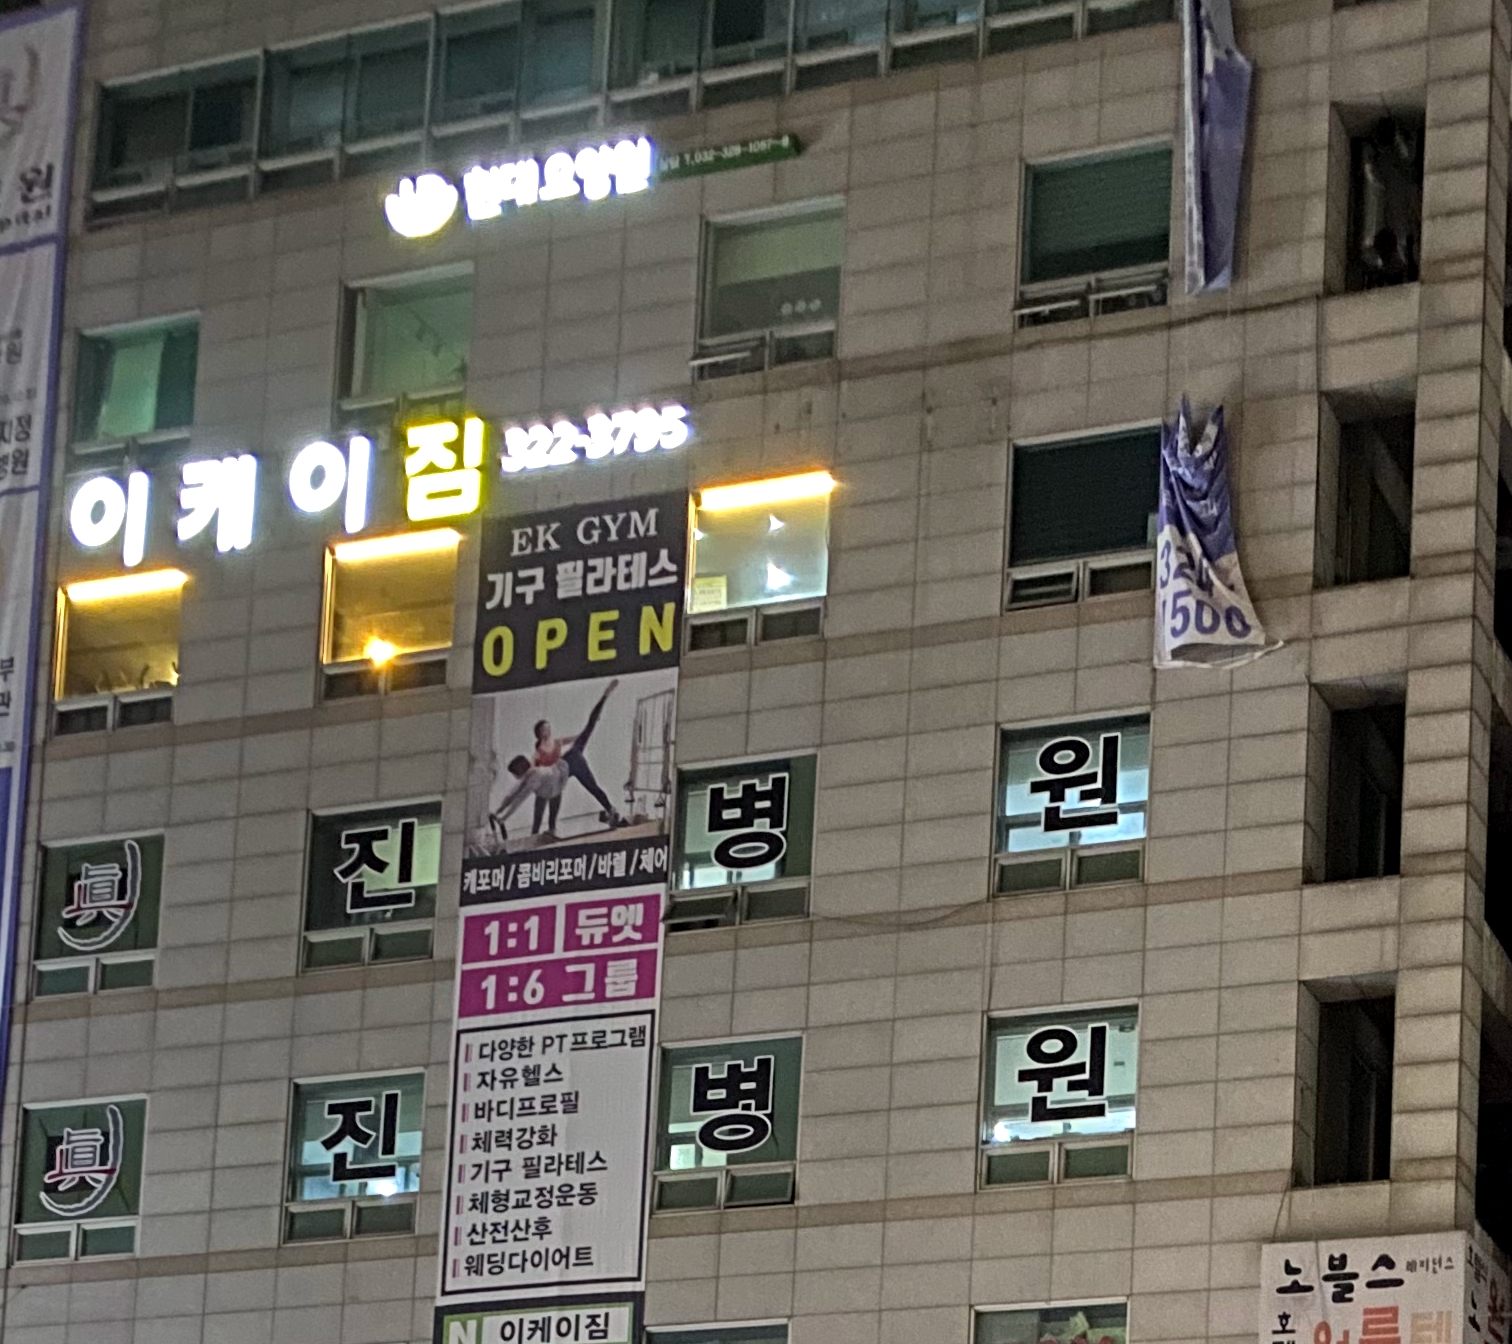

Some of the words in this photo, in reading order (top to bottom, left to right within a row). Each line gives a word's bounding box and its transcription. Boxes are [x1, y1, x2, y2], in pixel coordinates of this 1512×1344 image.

[500, 404, 691, 474] 322-3795
[512, 524, 560, 557] EK
[576, 508, 658, 543] GYM
[486, 566, 545, 610] 기구
[557, 552, 678, 600] 필라테스
[482, 602, 677, 677] OPEN
[334, 817, 419, 914] 진
[707, 772, 790, 870] 병
[1029, 732, 1121, 834] 원
[484, 916, 539, 955] 1:1
[575, 903, 643, 945] 듀엣
[481, 969, 544, 1010] 1:6
[562, 958, 637, 1002] 그룹
[479, 1036, 535, 1063] 다양한
[476, 1063, 564, 1092] 자유헬스
[320, 1089, 400, 1184] 진
[691, 1055, 774, 1154] 병
[1017, 1023, 1109, 1124] 원
[474, 1090, 580, 1123] 바디프로필
[471, 1124, 558, 1153] 체력강화
[470, 1159, 512, 1184] 기구
[522, 1150, 608, 1180] 필라테스
[468, 1181, 599, 1214] 체형교정운동
[466, 1216, 552, 1246] 산전산후
[464, 1245, 594, 1277] 웨딩다이어트
[1276, 1253, 1404, 1304] 노블스
[500, 1312, 610, 1344] 이케이짐
